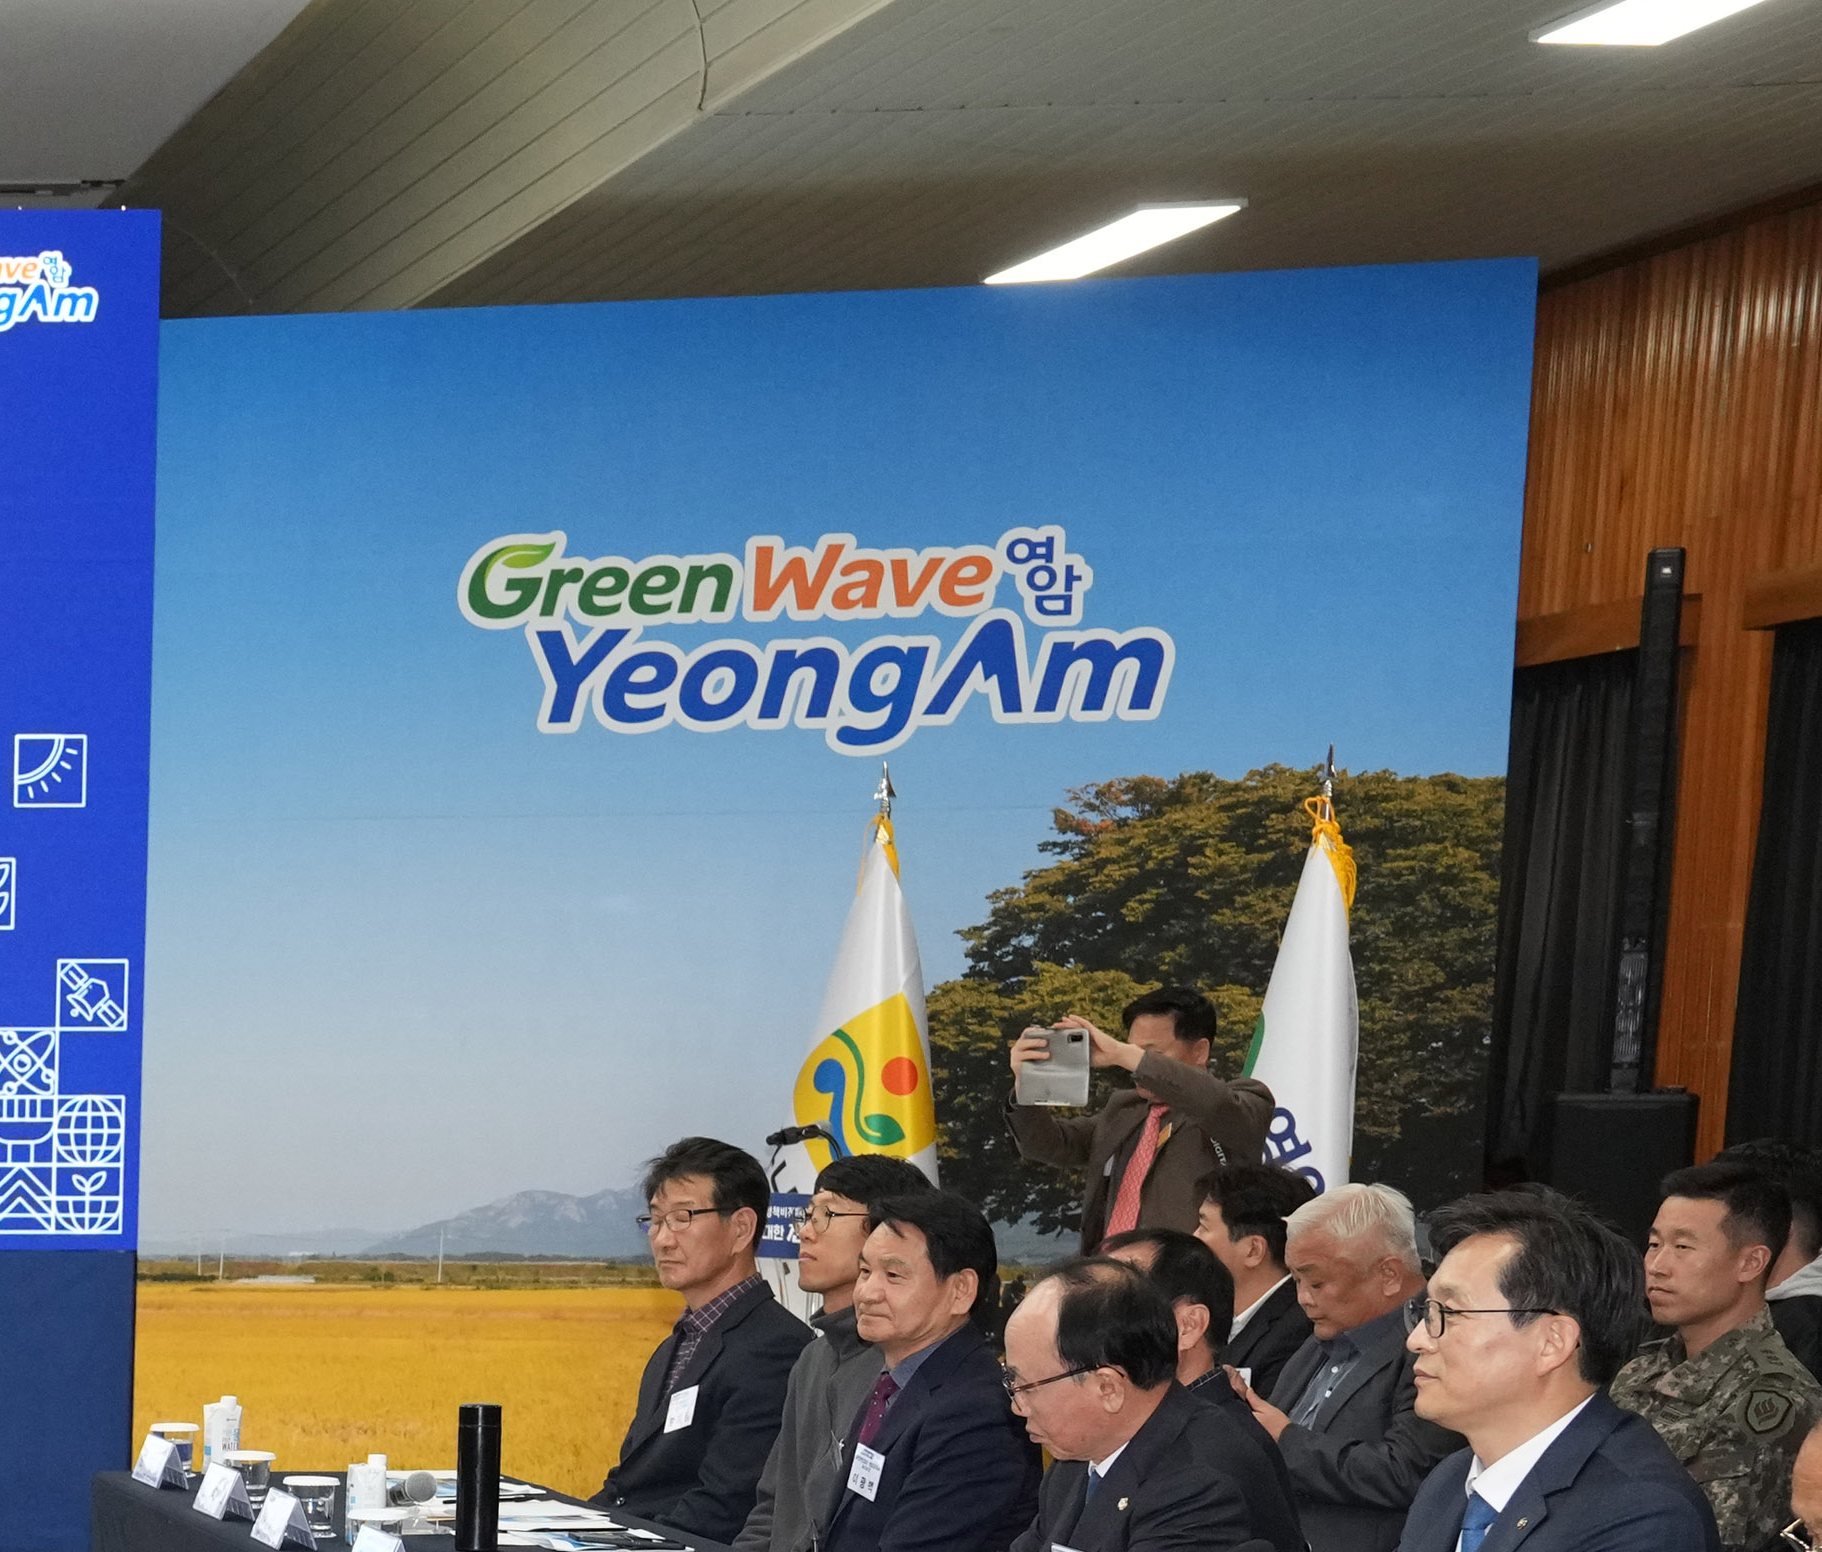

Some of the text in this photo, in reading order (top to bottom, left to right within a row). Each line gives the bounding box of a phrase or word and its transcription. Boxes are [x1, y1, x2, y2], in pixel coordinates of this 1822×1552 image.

[42, 255, 68, 284] 영암
[467, 535, 1083, 620] Green Wave 영암
[535, 618, 1166, 747] YeongAm
